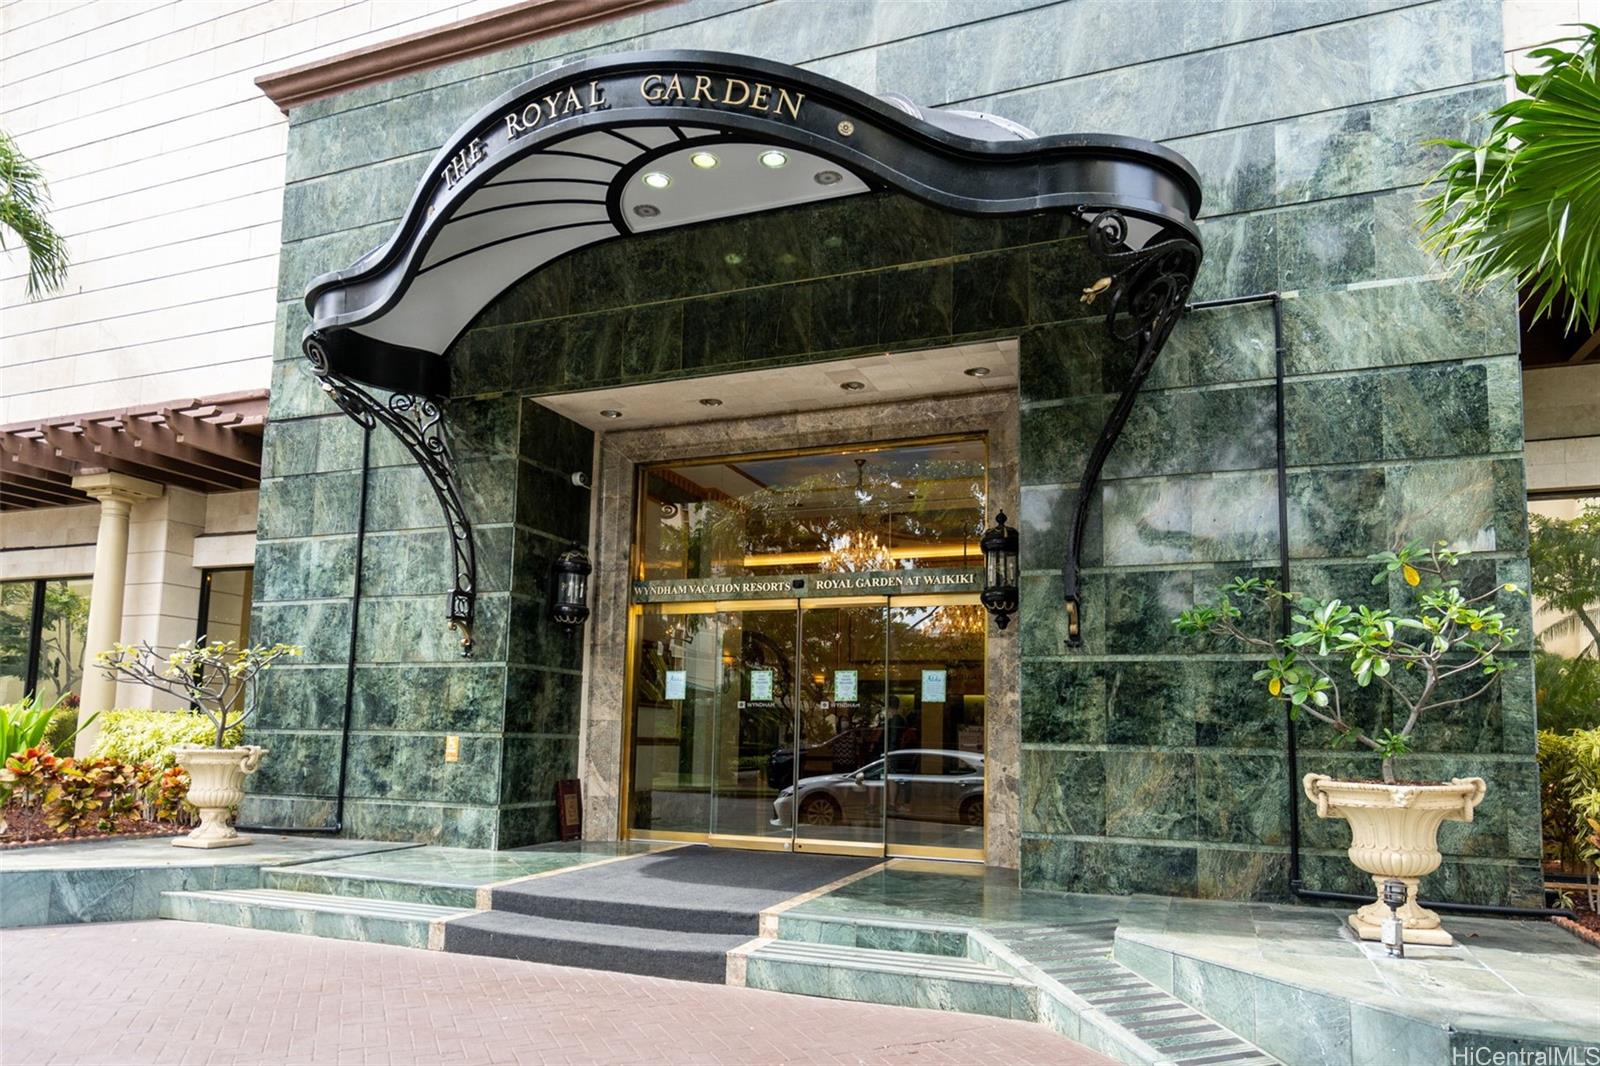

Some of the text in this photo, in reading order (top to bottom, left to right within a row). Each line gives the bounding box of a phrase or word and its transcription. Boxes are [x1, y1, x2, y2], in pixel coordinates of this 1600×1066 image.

[441, 74, 805, 190] THE ROYAL GARDEN
[634, 581, 791, 596] WYNDHAM VACATION RESORTS
[816, 573, 975, 590] ROYAL GARDEN AT WAIKIKI
